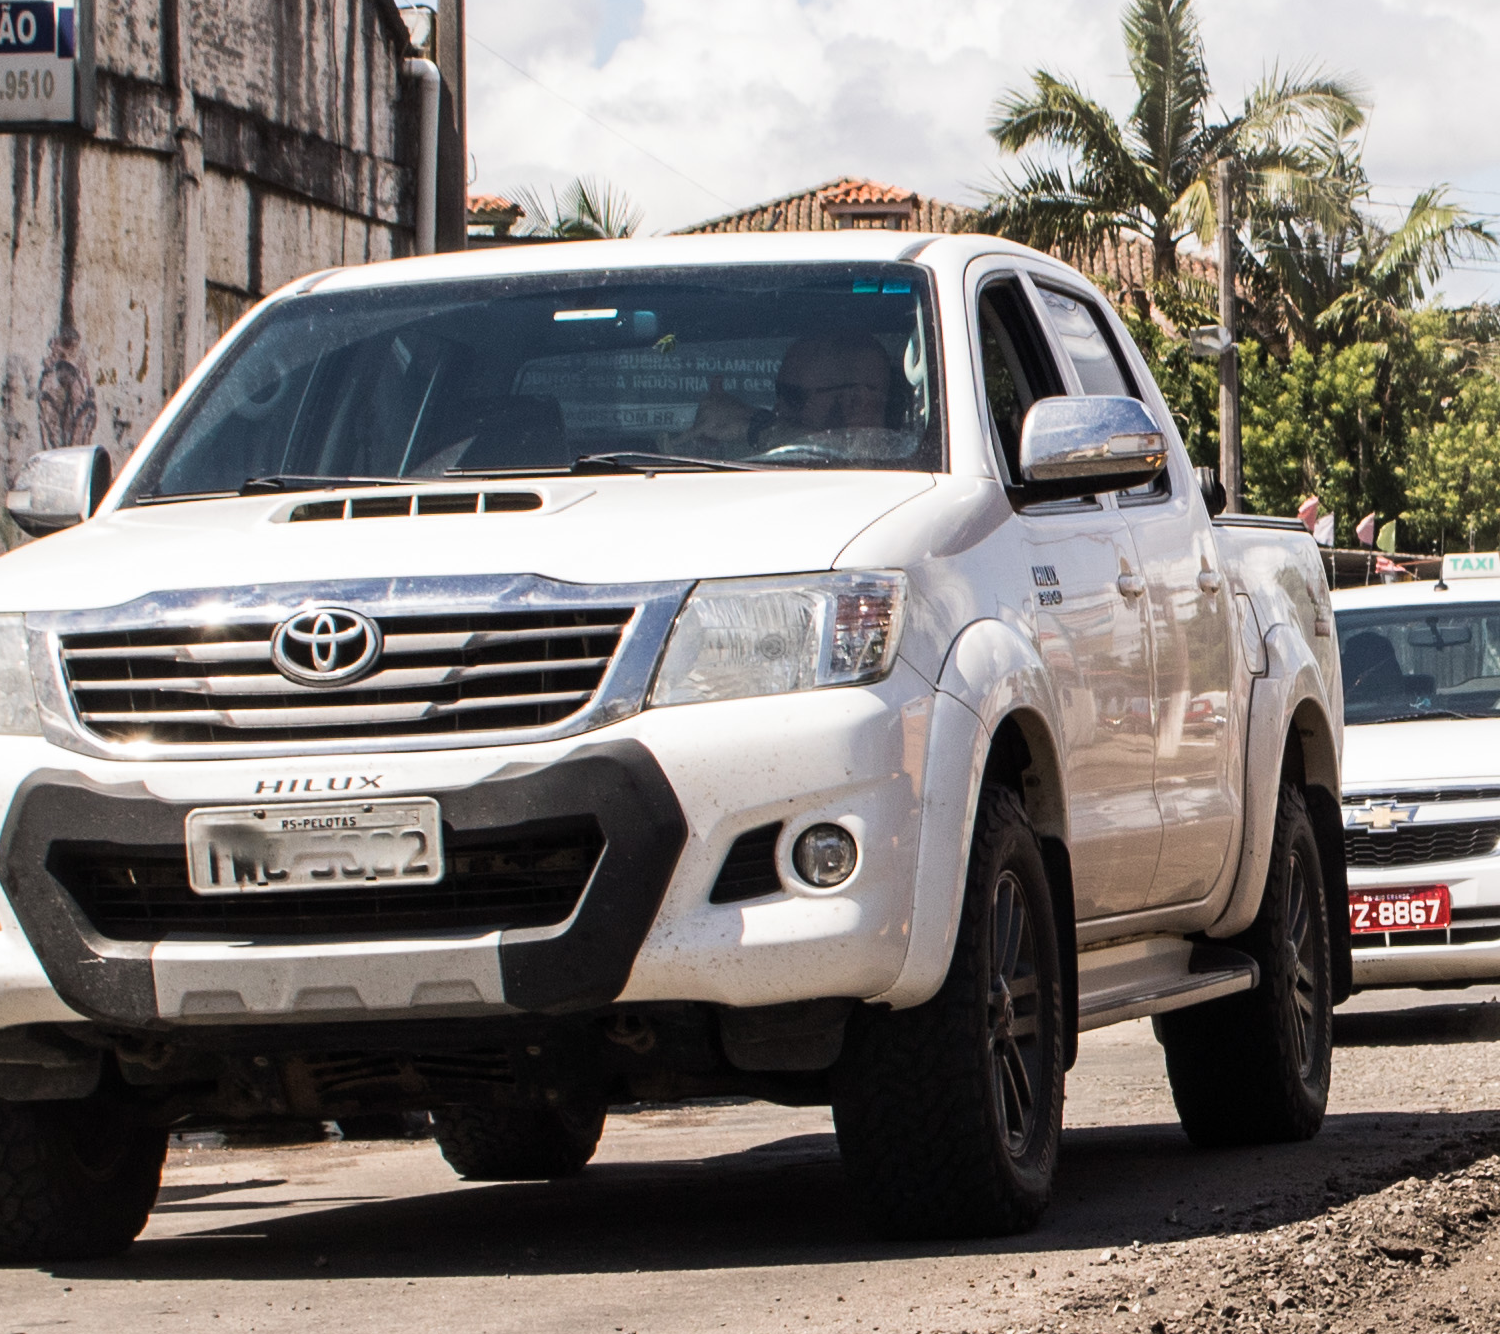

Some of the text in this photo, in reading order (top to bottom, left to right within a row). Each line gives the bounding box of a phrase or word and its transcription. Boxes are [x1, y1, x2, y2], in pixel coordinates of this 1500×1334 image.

[1449, 557, 1494, 571] TAXI
[254, 775, 384, 795] HILUX
[281, 816, 358, 831] RS-PELOTAS
